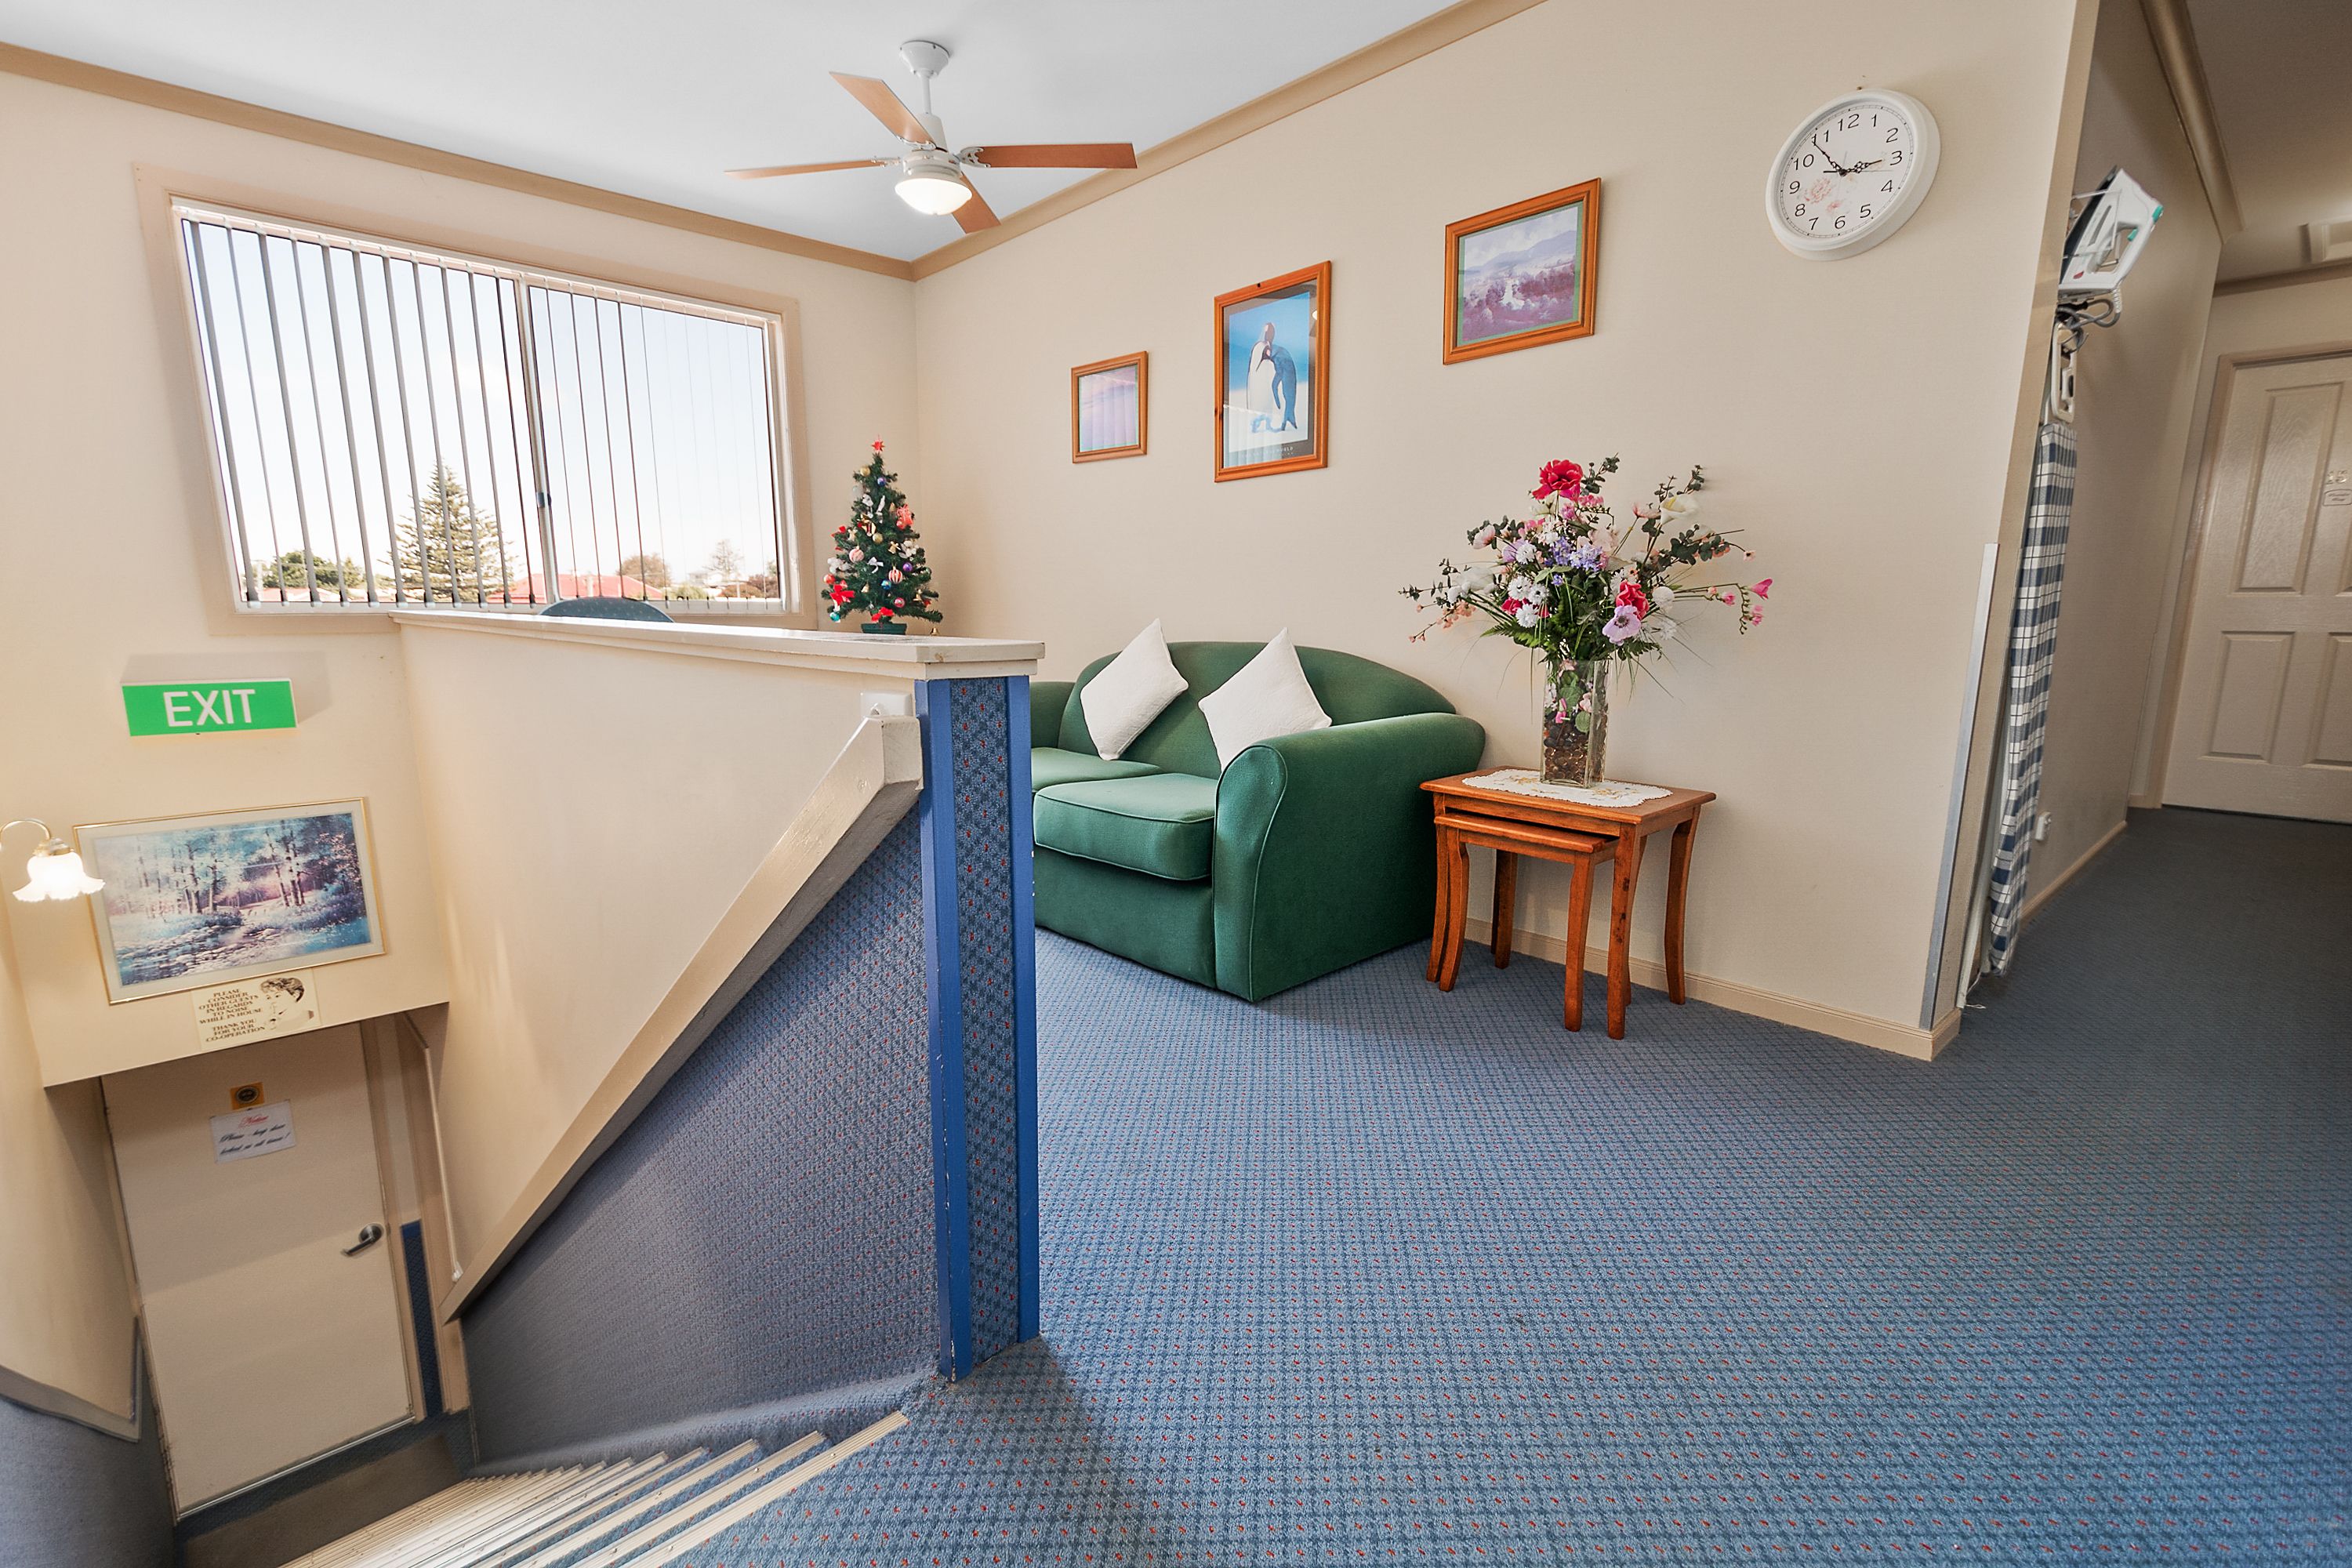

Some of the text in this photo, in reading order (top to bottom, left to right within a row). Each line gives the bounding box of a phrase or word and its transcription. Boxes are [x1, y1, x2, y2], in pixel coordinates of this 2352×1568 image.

[1837, 114, 1860, 132] 12
[1871, 114, 1877, 128] 1
[1812, 130, 1830, 146] 11
[1886, 128, 1899, 143] 2
[1794, 154, 1814, 171] 10
[1890, 151, 1902, 166] 3
[1789, 180, 1800, 194] 9
[1881, 180, 1893, 193] 4
[1795, 203, 1806, 217] 8
[1860, 204, 1871, 219] 5
[1809, 217, 1819, 230] 7
[1835, 216, 1846, 230] 6
[163, 689, 256, 728] EXIT
[208, 992, 249, 1004] CONSIDER
[213, 989, 240, 997] PLEASE
[198, 995, 259, 1010] OTHER GUESTS
[216, 1000, 253, 1011] REGARDS
[237, 1007, 263, 1017] HOUSE
[205, 1025, 266, 1042] CO-OPERATION
[212, 1022, 239, 1031] THANK
[231, 1023, 255, 1032] YOUR
